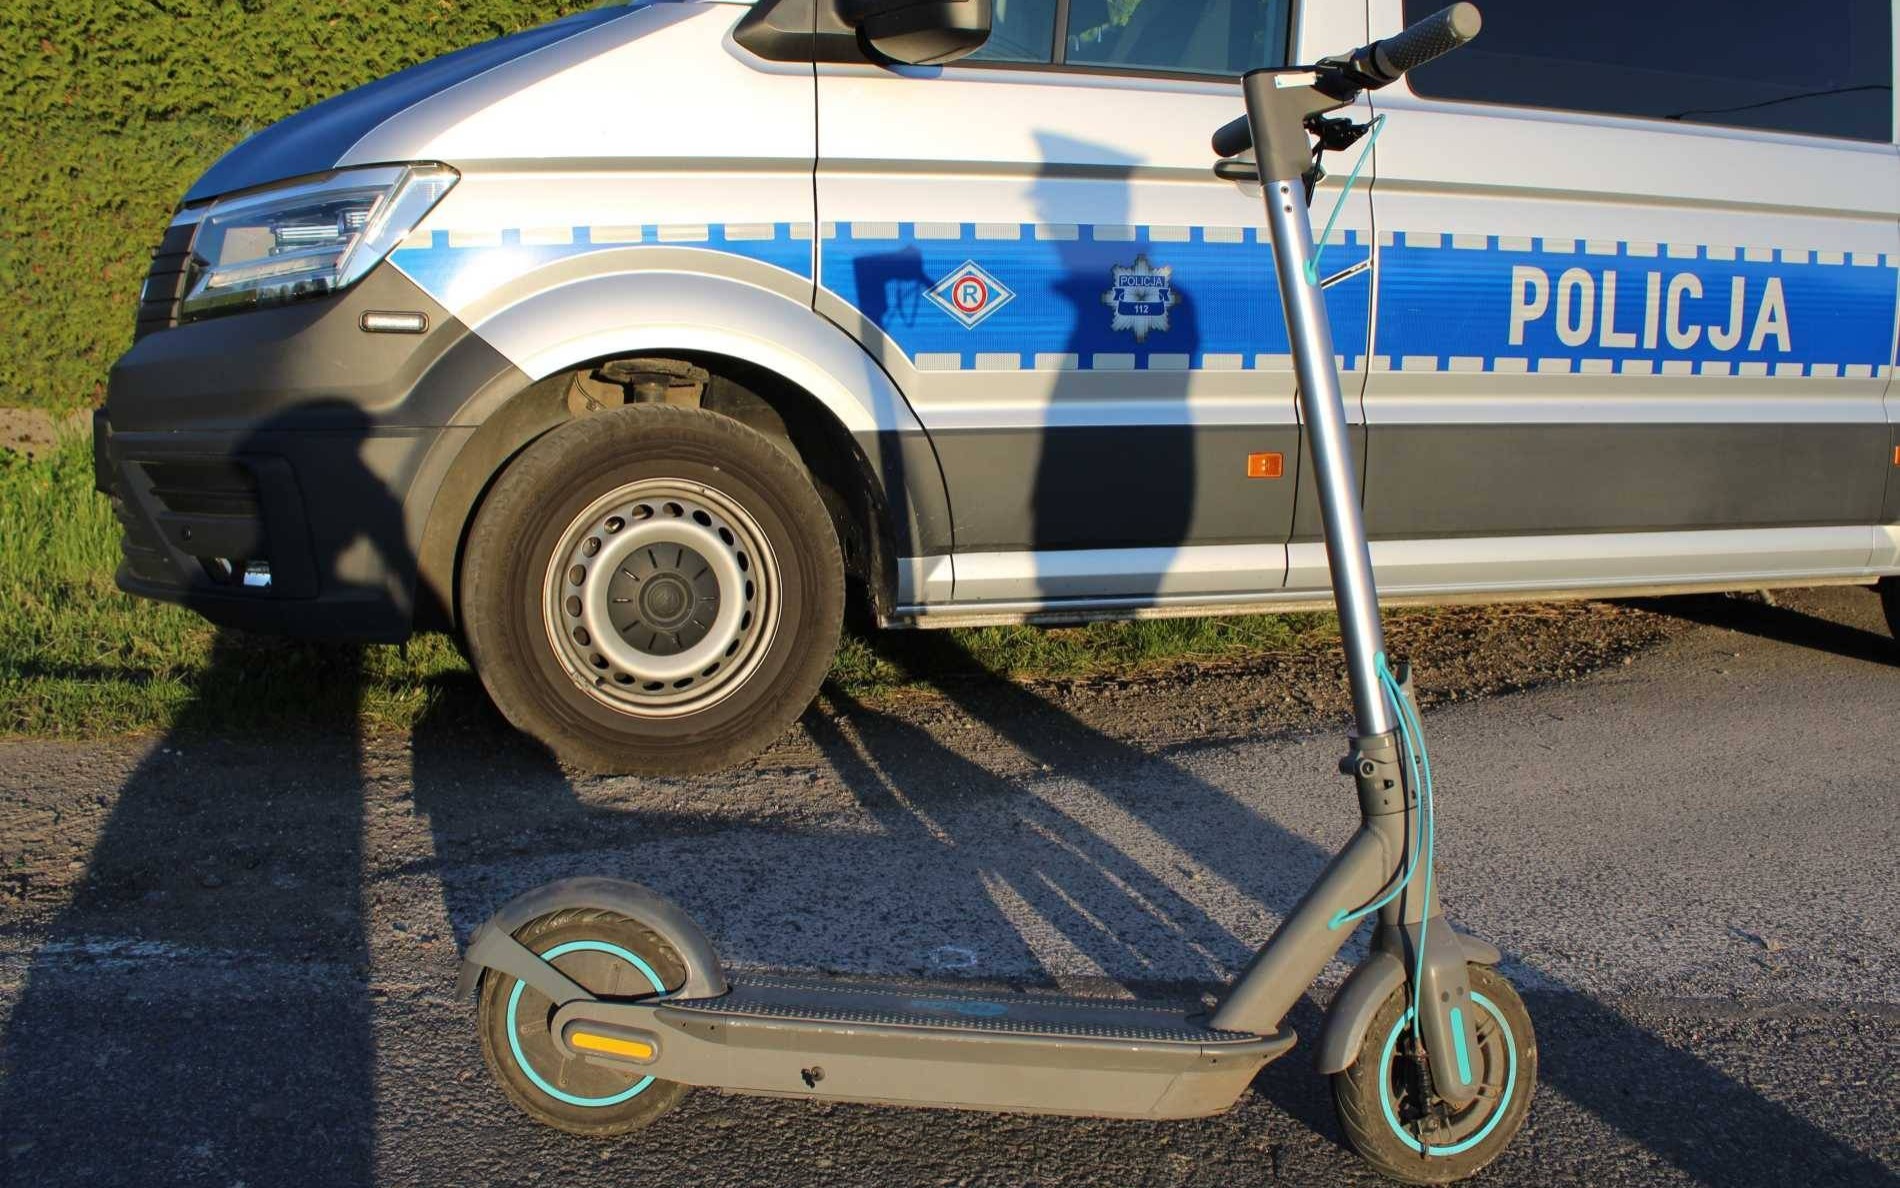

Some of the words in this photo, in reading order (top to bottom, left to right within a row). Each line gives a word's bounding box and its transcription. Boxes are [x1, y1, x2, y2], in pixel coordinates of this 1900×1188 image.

[1120, 276, 1163, 286] POLICJA
[963, 285, 978, 304] R
[1134, 305, 1150, 314] 112
[1508, 265, 1791, 352] POLICJA
